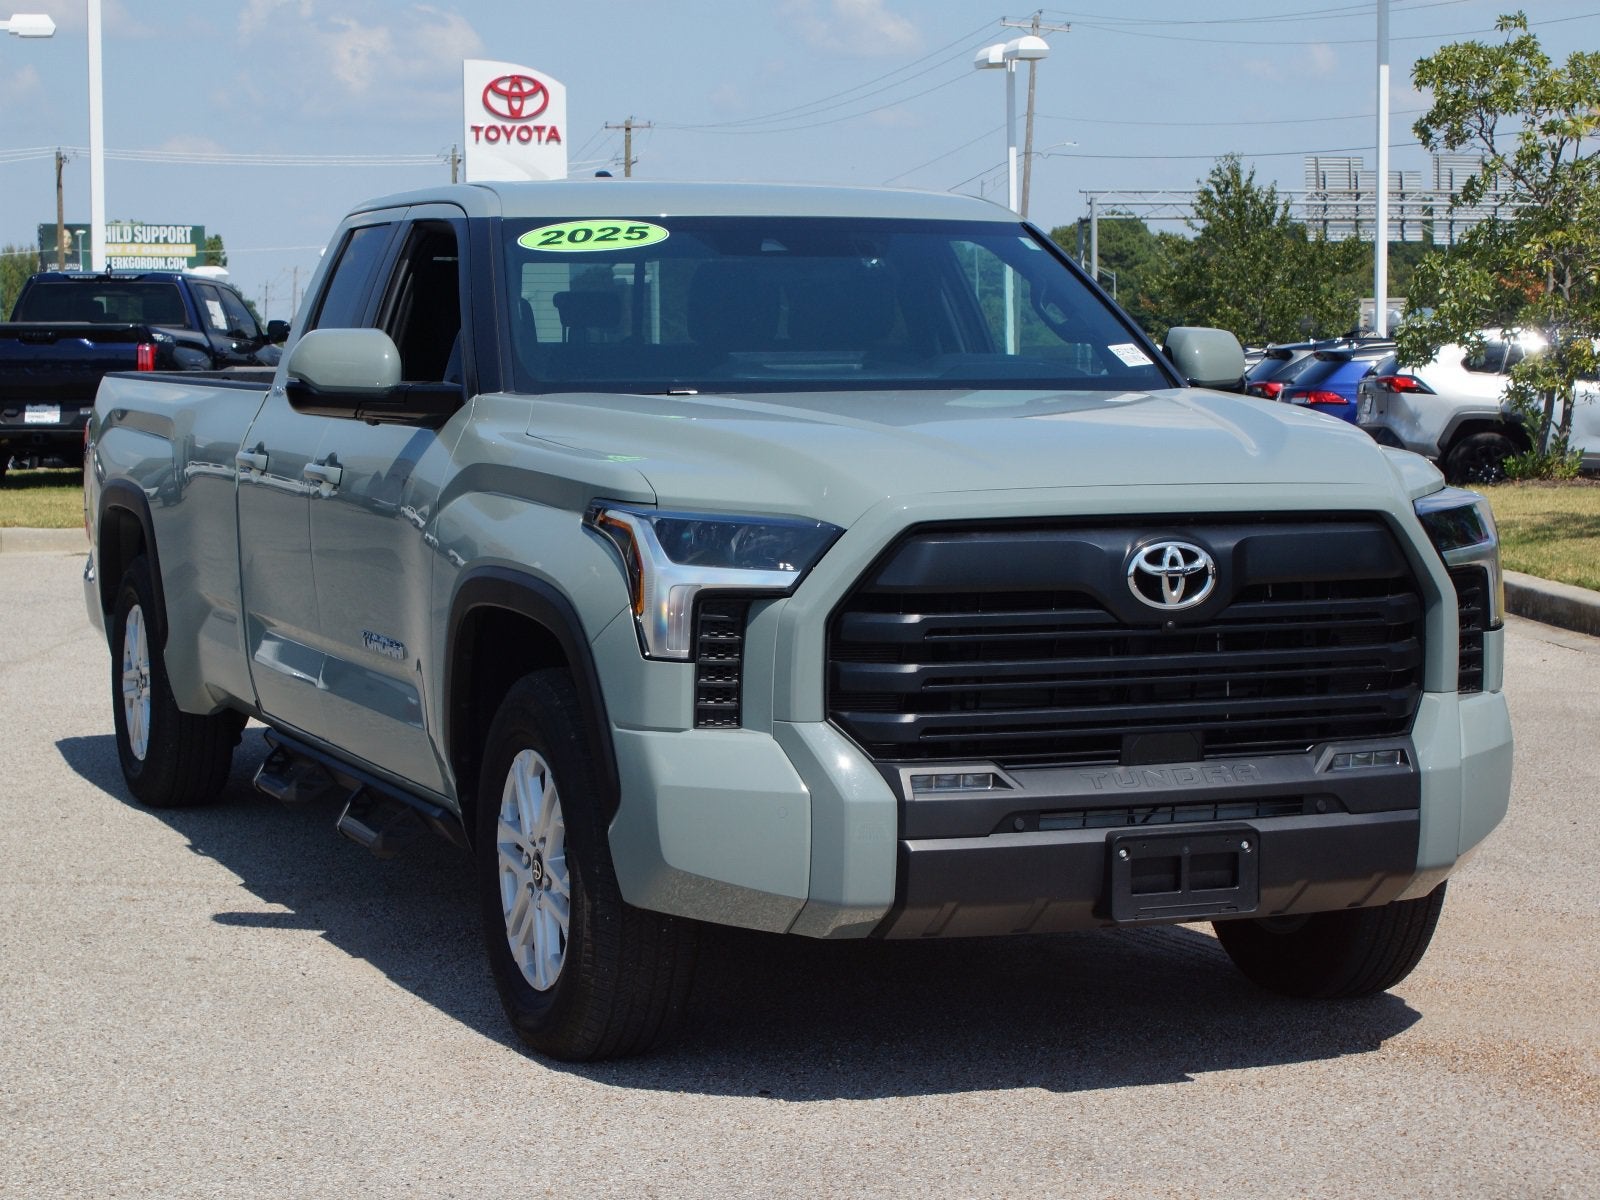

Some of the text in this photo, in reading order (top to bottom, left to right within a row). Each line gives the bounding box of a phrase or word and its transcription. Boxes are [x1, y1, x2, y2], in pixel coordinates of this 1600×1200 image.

[470, 126, 561, 144] TOYOTA
[105, 226, 193, 243] HILD SUPPORT
[537, 226, 650, 246] 2025
[105, 257, 188, 270] LERKGORDON.COM
[1081, 764, 1260, 790] TUNDRA
